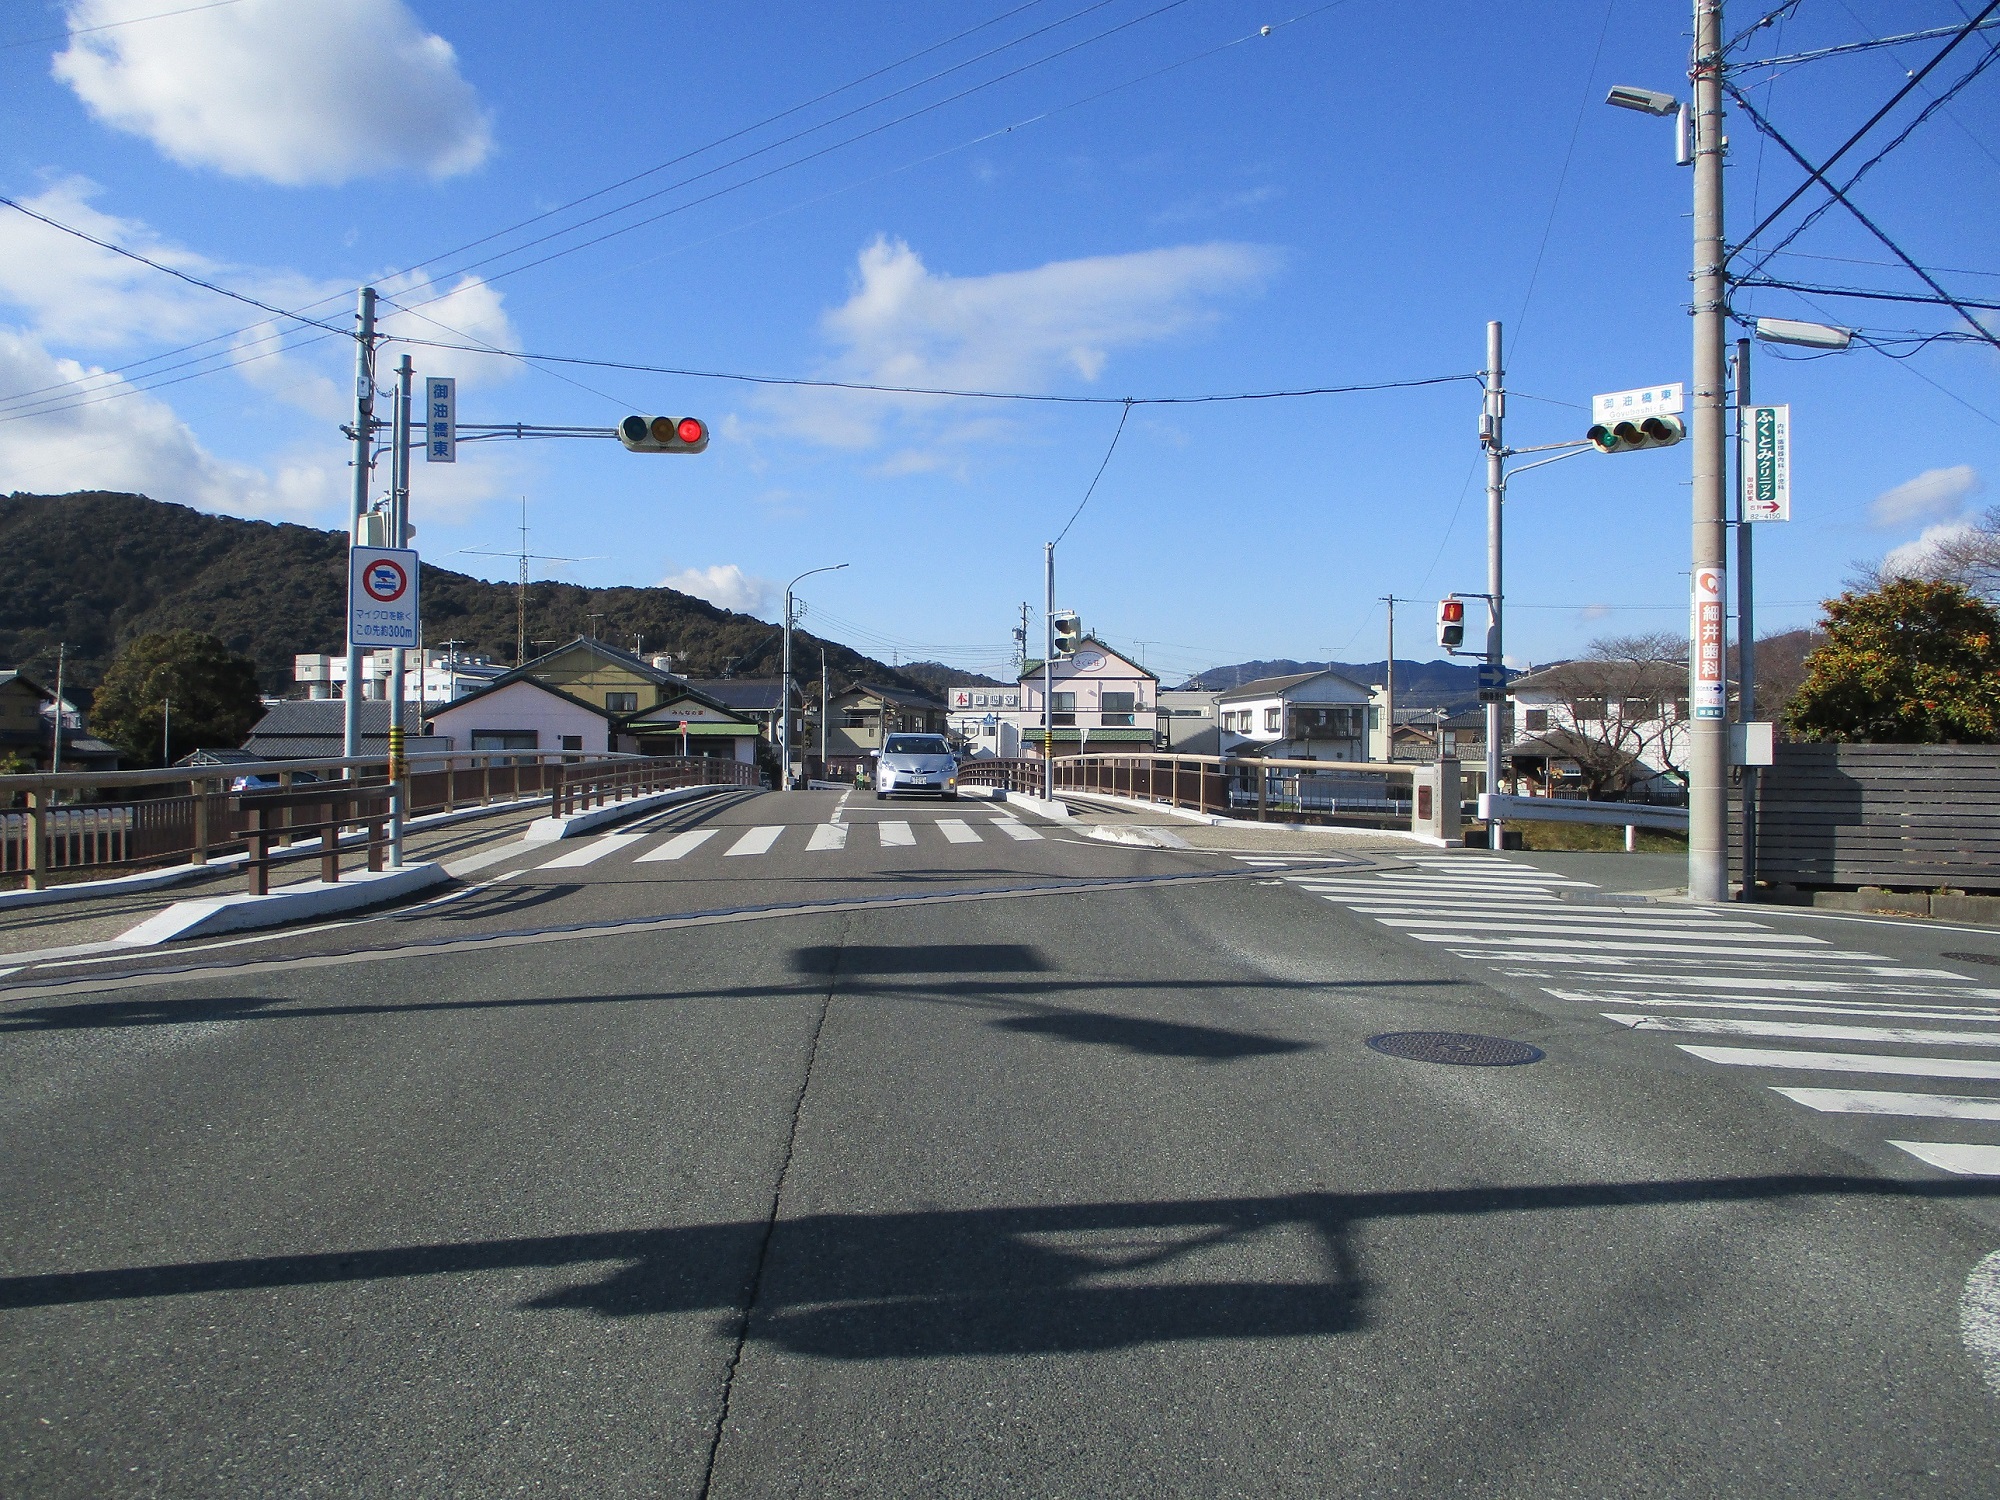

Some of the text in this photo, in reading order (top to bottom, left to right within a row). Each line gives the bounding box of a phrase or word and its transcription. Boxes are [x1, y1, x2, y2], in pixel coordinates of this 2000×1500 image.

[433, 384, 448, 457] 御油橋東
[1603, 389, 1672, 410] 御油橋東
[1757, 411, 1773, 500] ふくとみクリニック
[356, 609, 412, 621] マイクロを除く
[356, 624, 412, 638] この先約300m
[1702, 604, 1719, 678] 細井歯科
